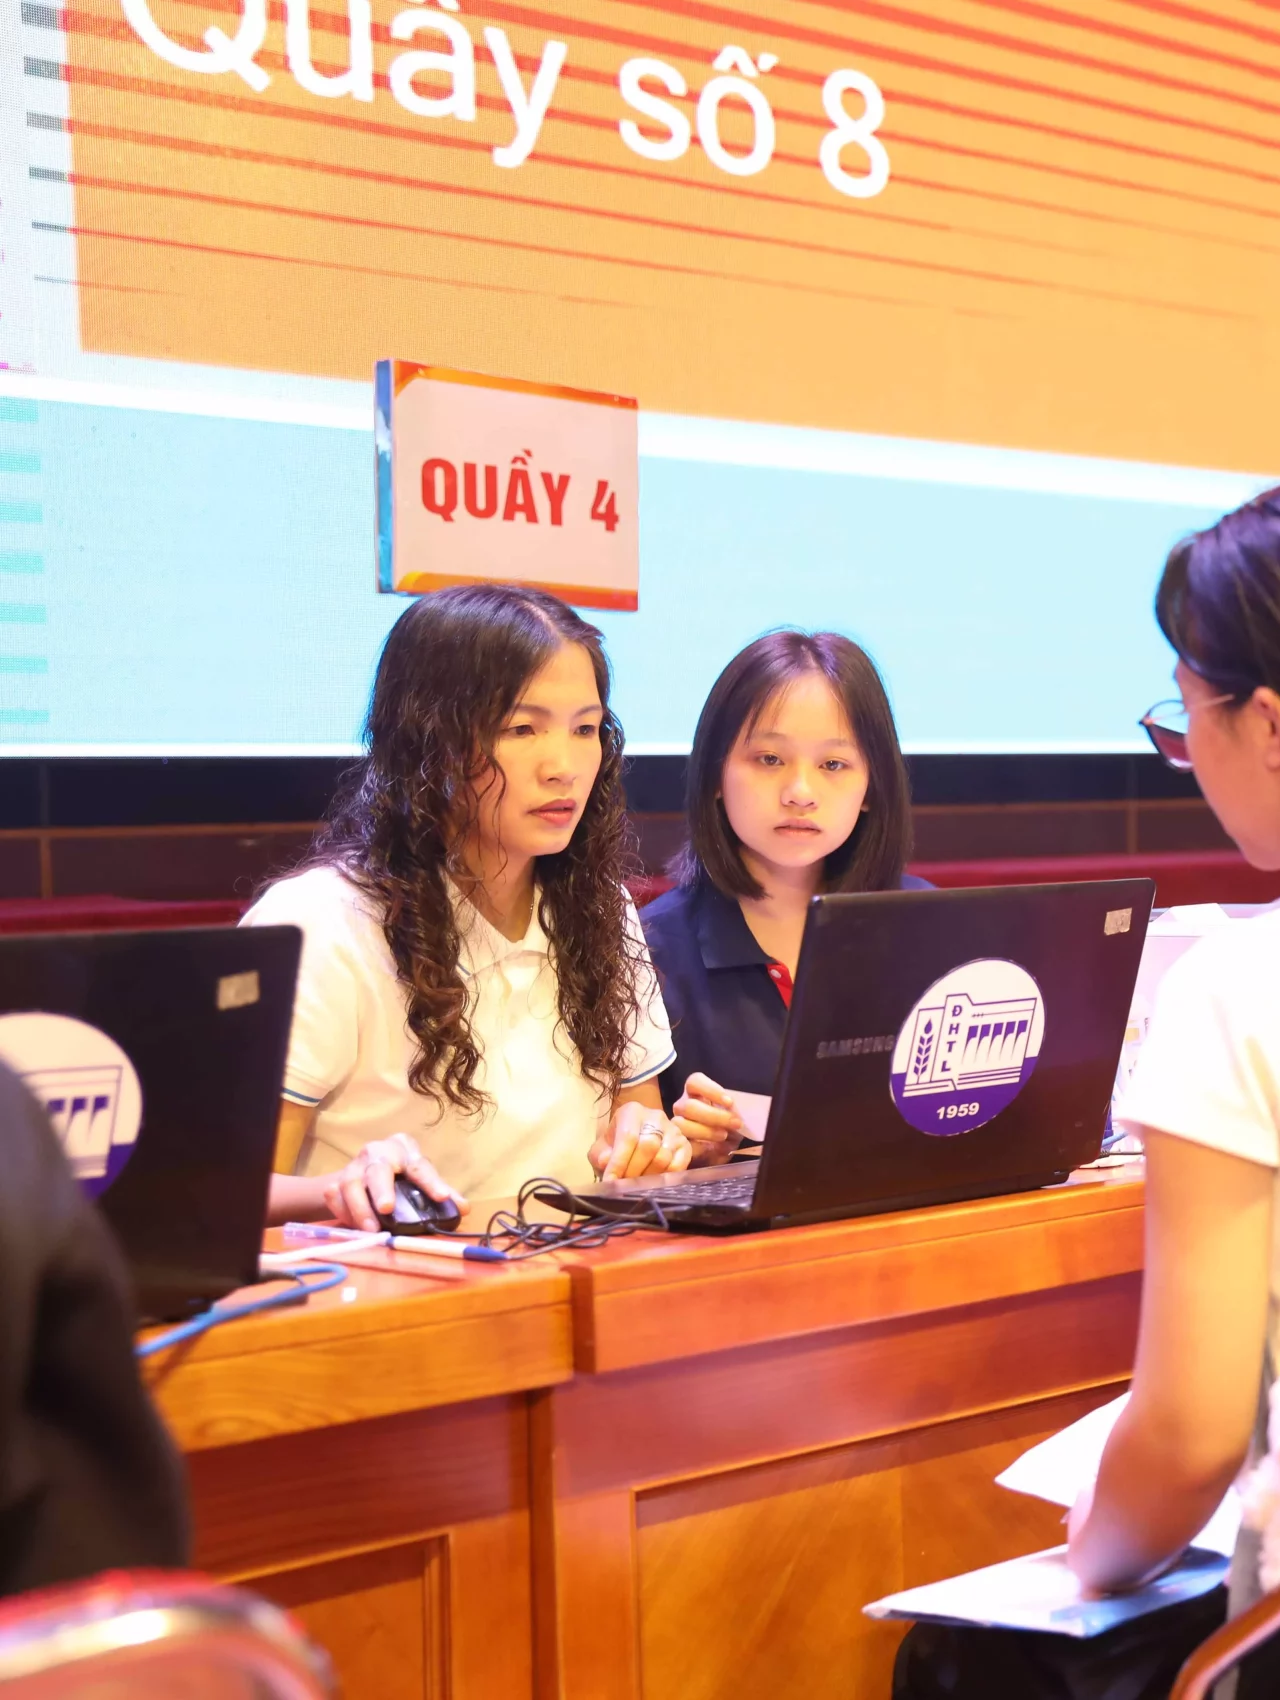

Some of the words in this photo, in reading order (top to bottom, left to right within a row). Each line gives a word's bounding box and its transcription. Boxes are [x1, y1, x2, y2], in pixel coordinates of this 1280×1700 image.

[618, 45, 779, 176] số
[819, 68, 890, 198] 8
[421, 449, 571, 527] QUẦY
[590, 479, 619, 532] 4
[816, 1034, 895, 1059] SAMSUNG
[936, 1102, 980, 1120] 1959
